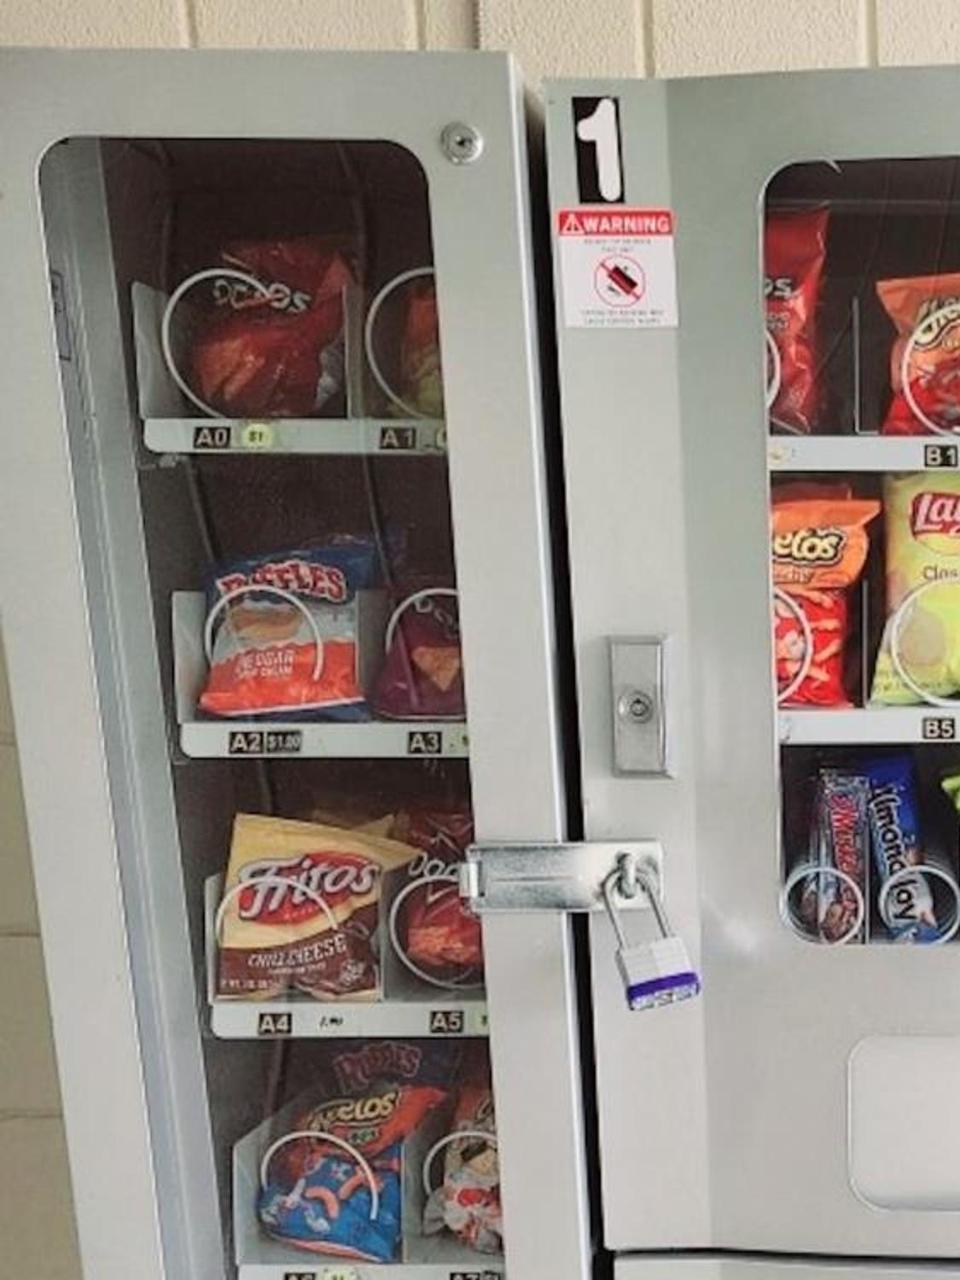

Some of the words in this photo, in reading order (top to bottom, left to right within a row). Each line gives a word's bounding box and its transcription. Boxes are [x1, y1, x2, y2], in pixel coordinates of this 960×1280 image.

[577, 98, 622, 201] 1
[582, 215, 670, 233] WARNING
[195, 428, 229, 447] A0
[383, 428, 415, 446] A1
[926, 447, 957, 465] B1
[925, 719, 955, 738] B5
[231, 733, 263, 752] A2
[409, 734, 440, 752] A3
[238, 856, 381, 920] Fritos
[260, 1015, 291, 1033] A4
[432, 1013, 462, 1031] A5
